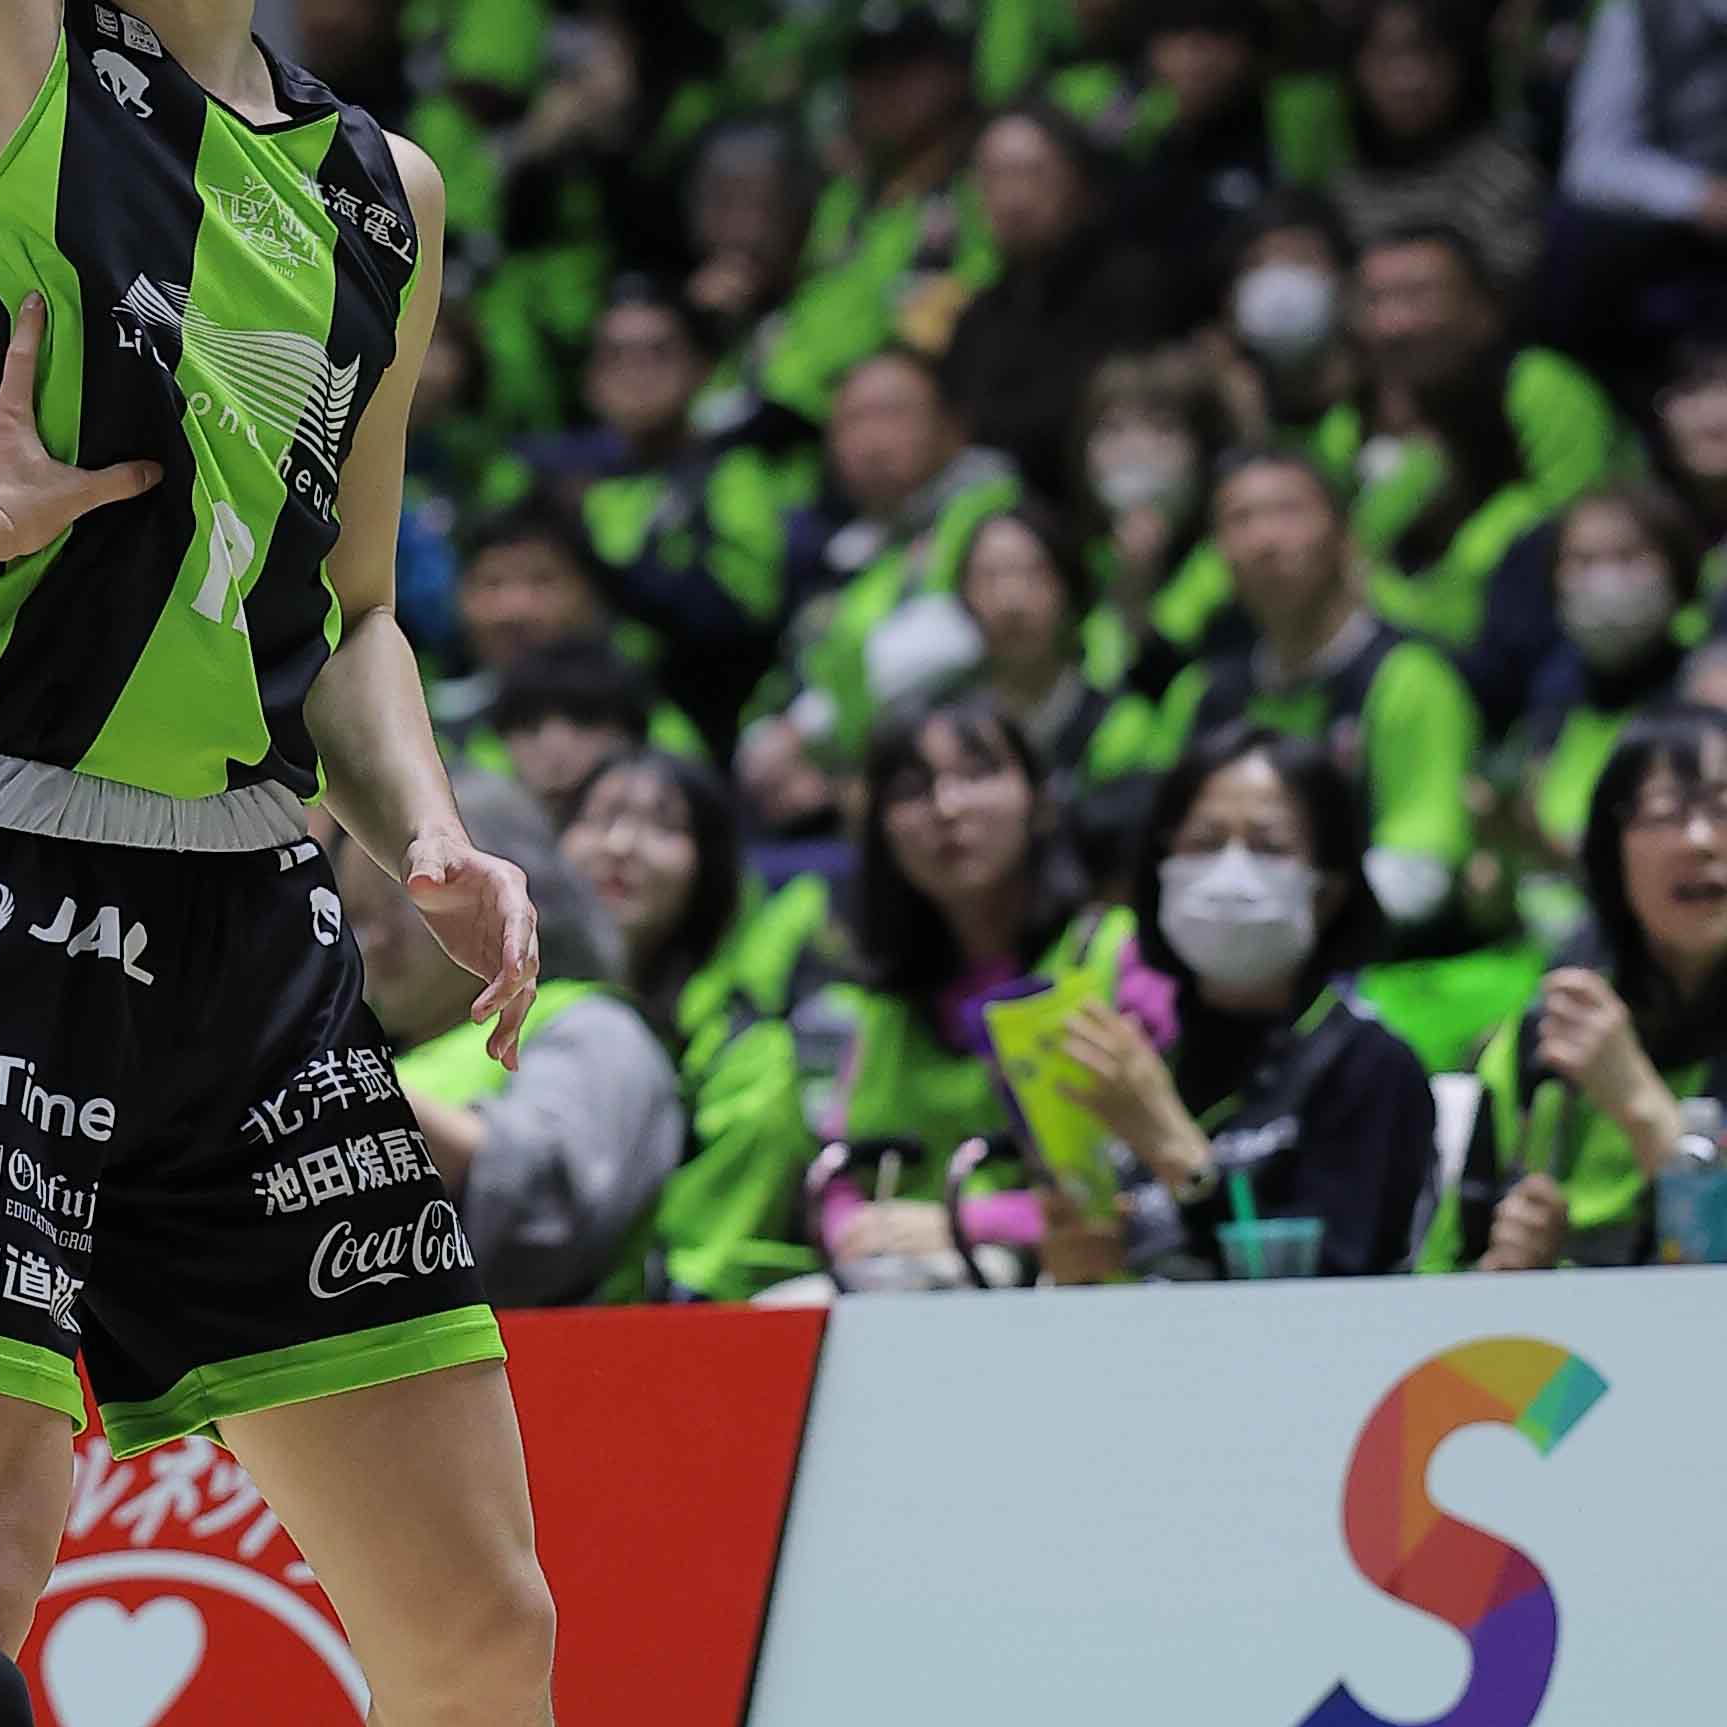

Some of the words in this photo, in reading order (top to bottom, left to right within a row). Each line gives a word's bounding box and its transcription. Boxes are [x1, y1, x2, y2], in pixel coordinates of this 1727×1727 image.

[28, 895, 154, 986] JAL
[239, 1044, 401, 1145] 北洋銀
